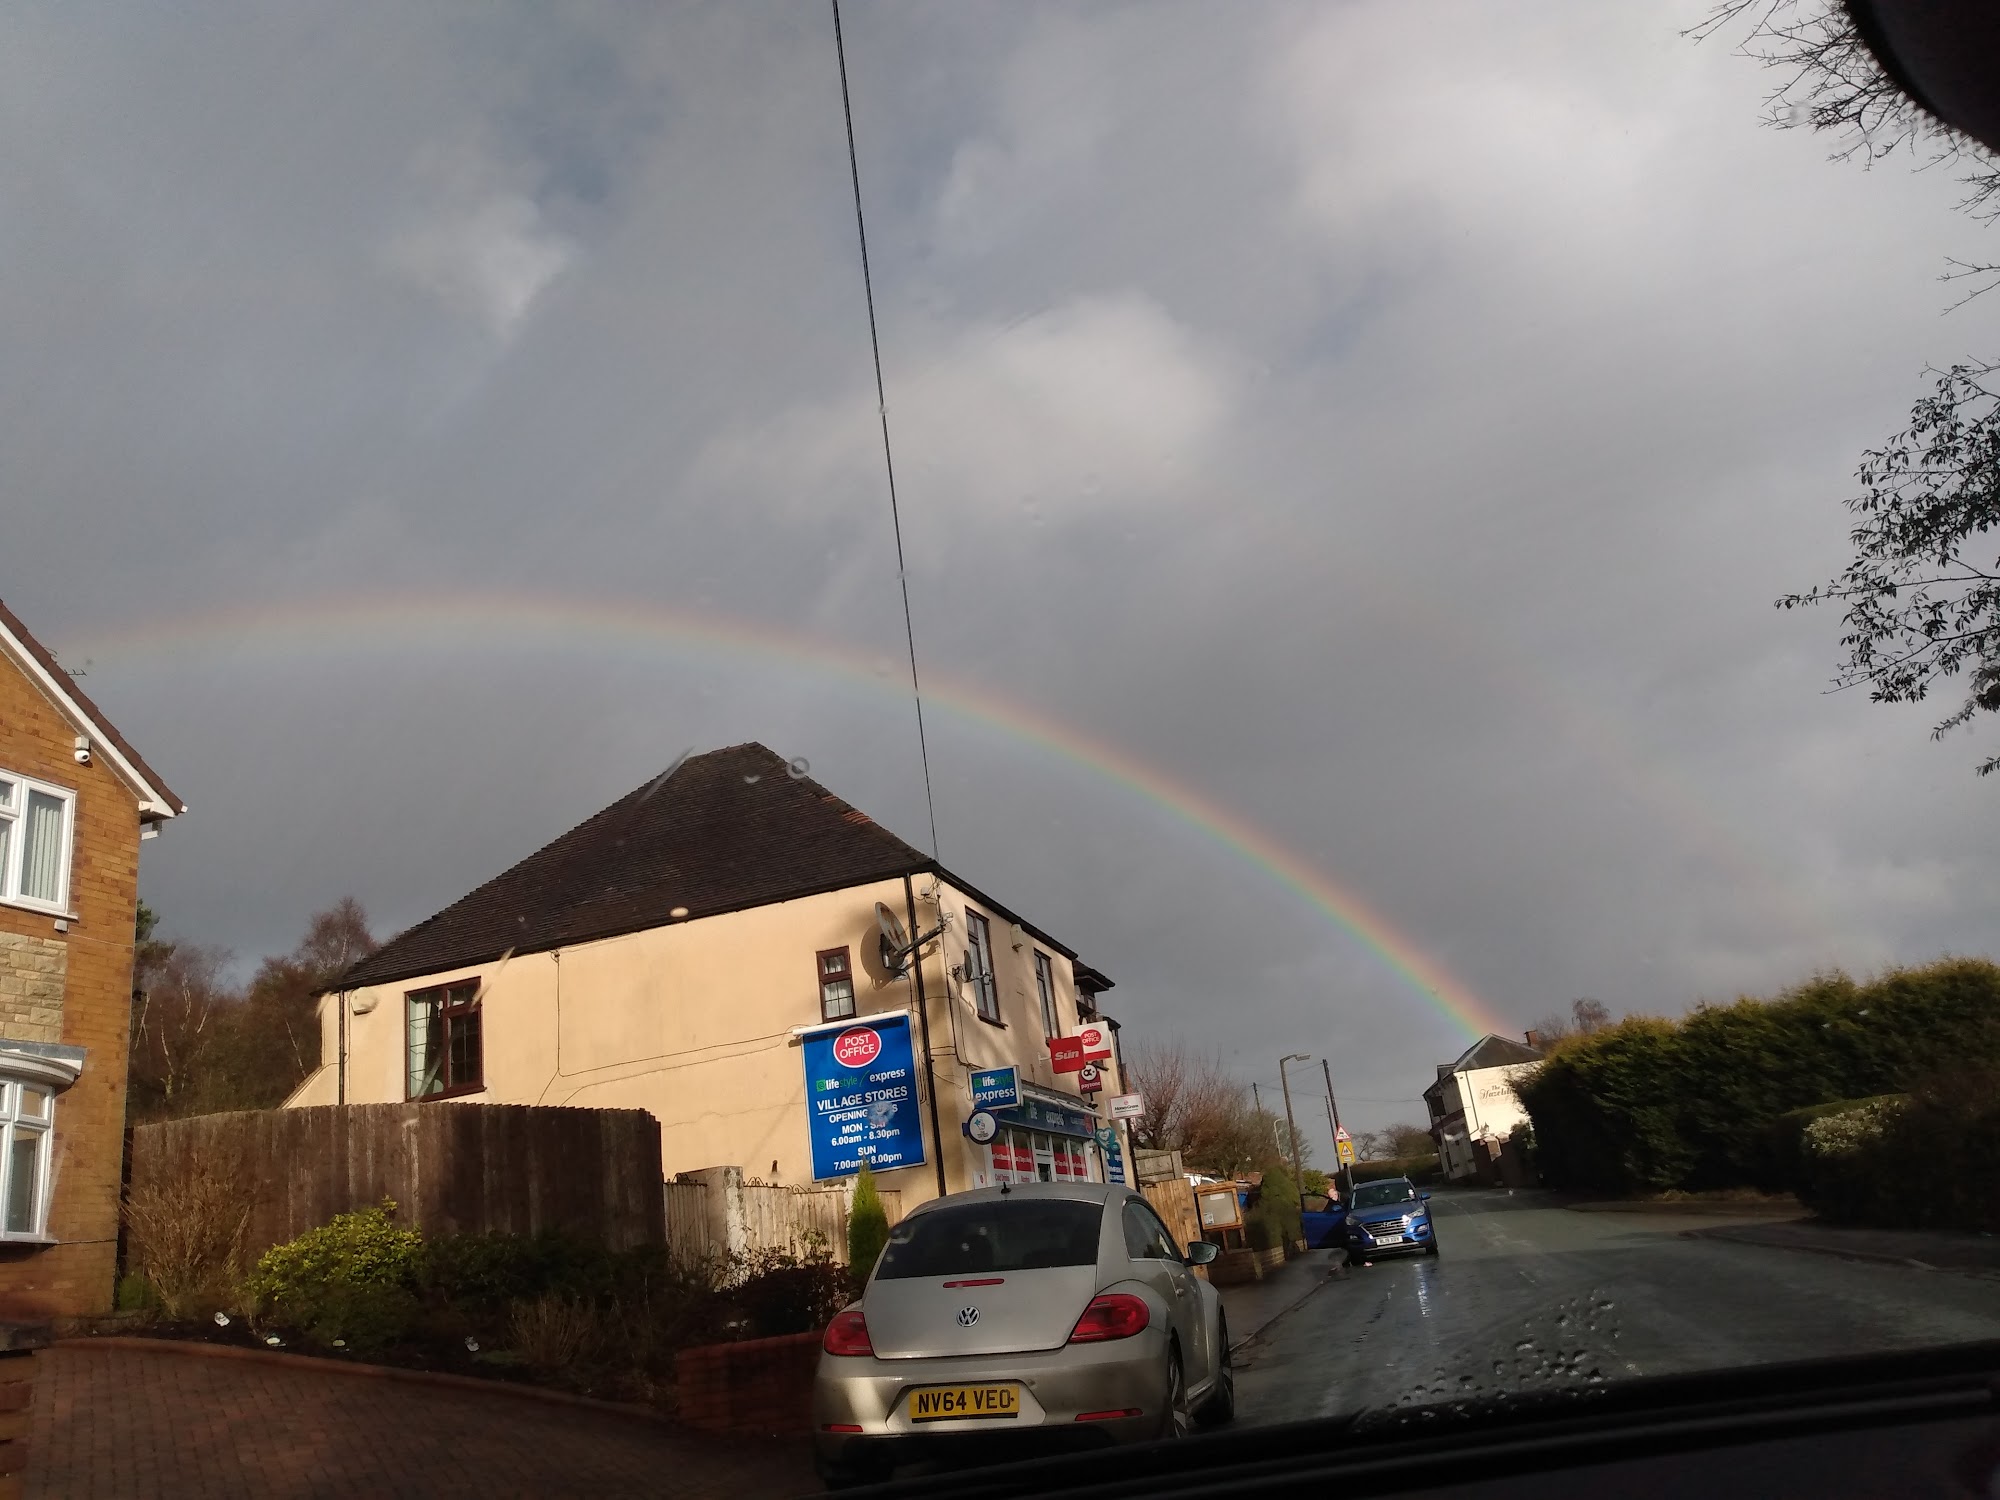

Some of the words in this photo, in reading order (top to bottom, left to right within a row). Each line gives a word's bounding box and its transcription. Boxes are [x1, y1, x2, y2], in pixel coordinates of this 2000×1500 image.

[844, 1034, 870, 1047] POST
[1082, 1036, 1099, 1044] OFFICE
[840, 1043, 875, 1059] OFFICE
[1055, 1050, 1079, 1061] Sun
[869, 1068, 906, 1083] express
[817, 1094, 862, 1110] VILLAGE
[865, 1086, 907, 1102] STORES
[975, 1087, 1015, 1103] express
[829, 1109, 868, 1124] OPENING
[842, 1123, 863, 1135] MON
[831, 1135, 862, 1147] 6.00am
[869, 1128, 900, 1141] 8.30pm
[857, 1145, 877, 1156] SUN
[834, 1160, 863, 1170] 7.00am
[871, 1153, 902, 1165] 8.00pm
[918, 1391, 967, 1414] NV64
[973, 1389, 1011, 1409] VEO
